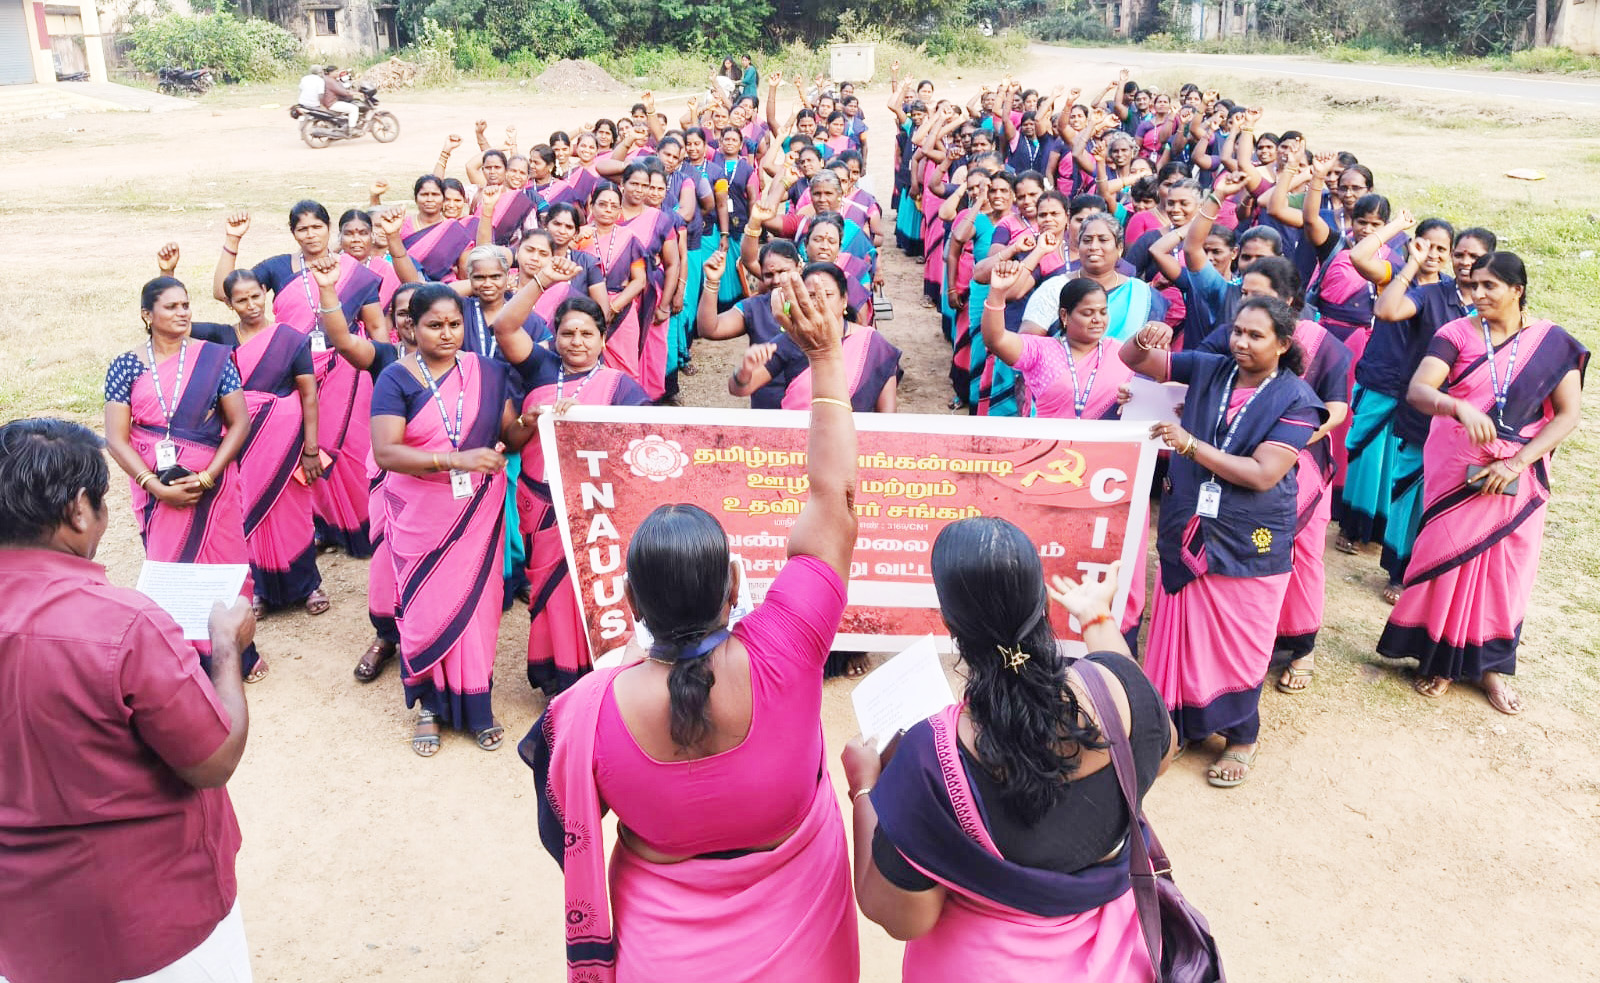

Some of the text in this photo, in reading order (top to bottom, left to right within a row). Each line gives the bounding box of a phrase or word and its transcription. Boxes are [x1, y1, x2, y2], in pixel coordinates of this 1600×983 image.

[693, 445, 808, 468] தமிழ்நா
[747, 473, 958, 499] ஊழி மற்றும்
[886, 503, 983, 519] சங்கம்
[576, 450, 628, 640] TNAUUS
[874, 561, 933, 577] வட்ட
